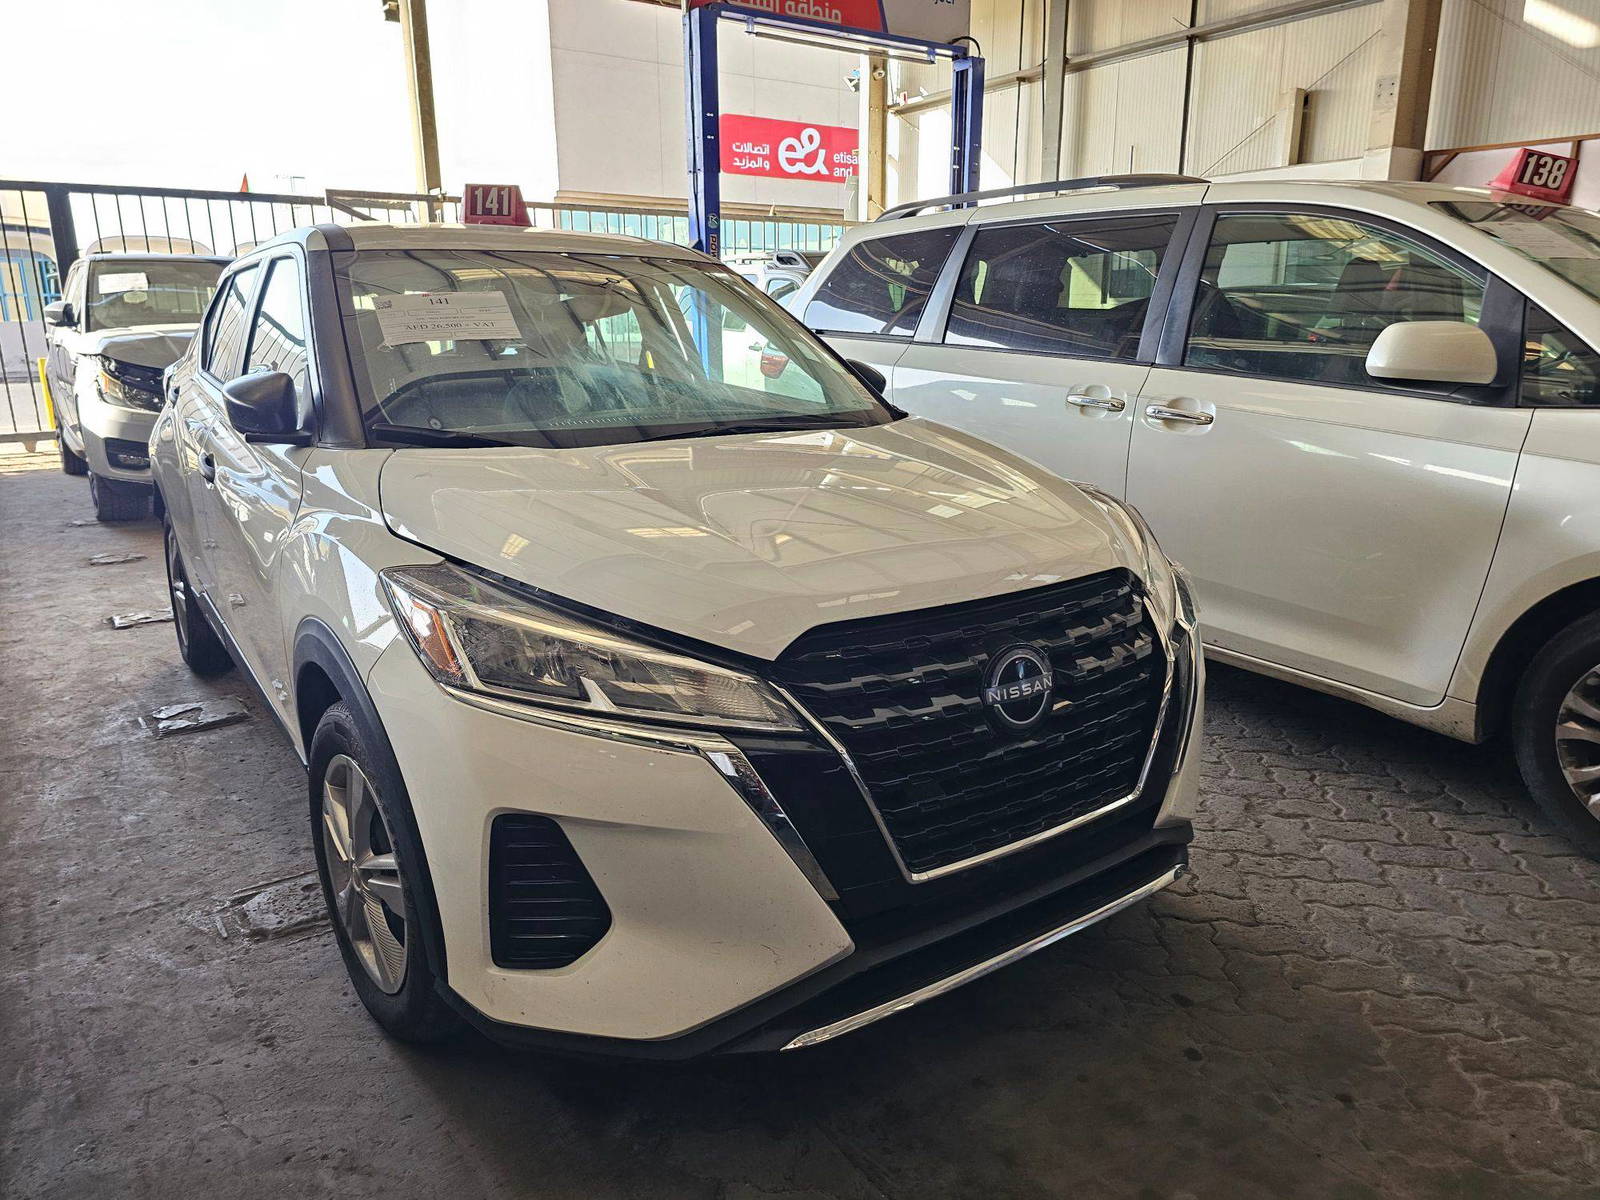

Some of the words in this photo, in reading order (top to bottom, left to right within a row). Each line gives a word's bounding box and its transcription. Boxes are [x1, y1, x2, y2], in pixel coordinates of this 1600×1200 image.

[732, 142, 770, 155] اتصالات
[778, 127, 829, 175] e&
[732, 156, 770, 170] والمزيد
[833, 166, 853, 177] and
[1522, 154, 1568, 189] 138
[474, 187, 509, 215] 141
[988, 676, 1052, 702] NISSAN
